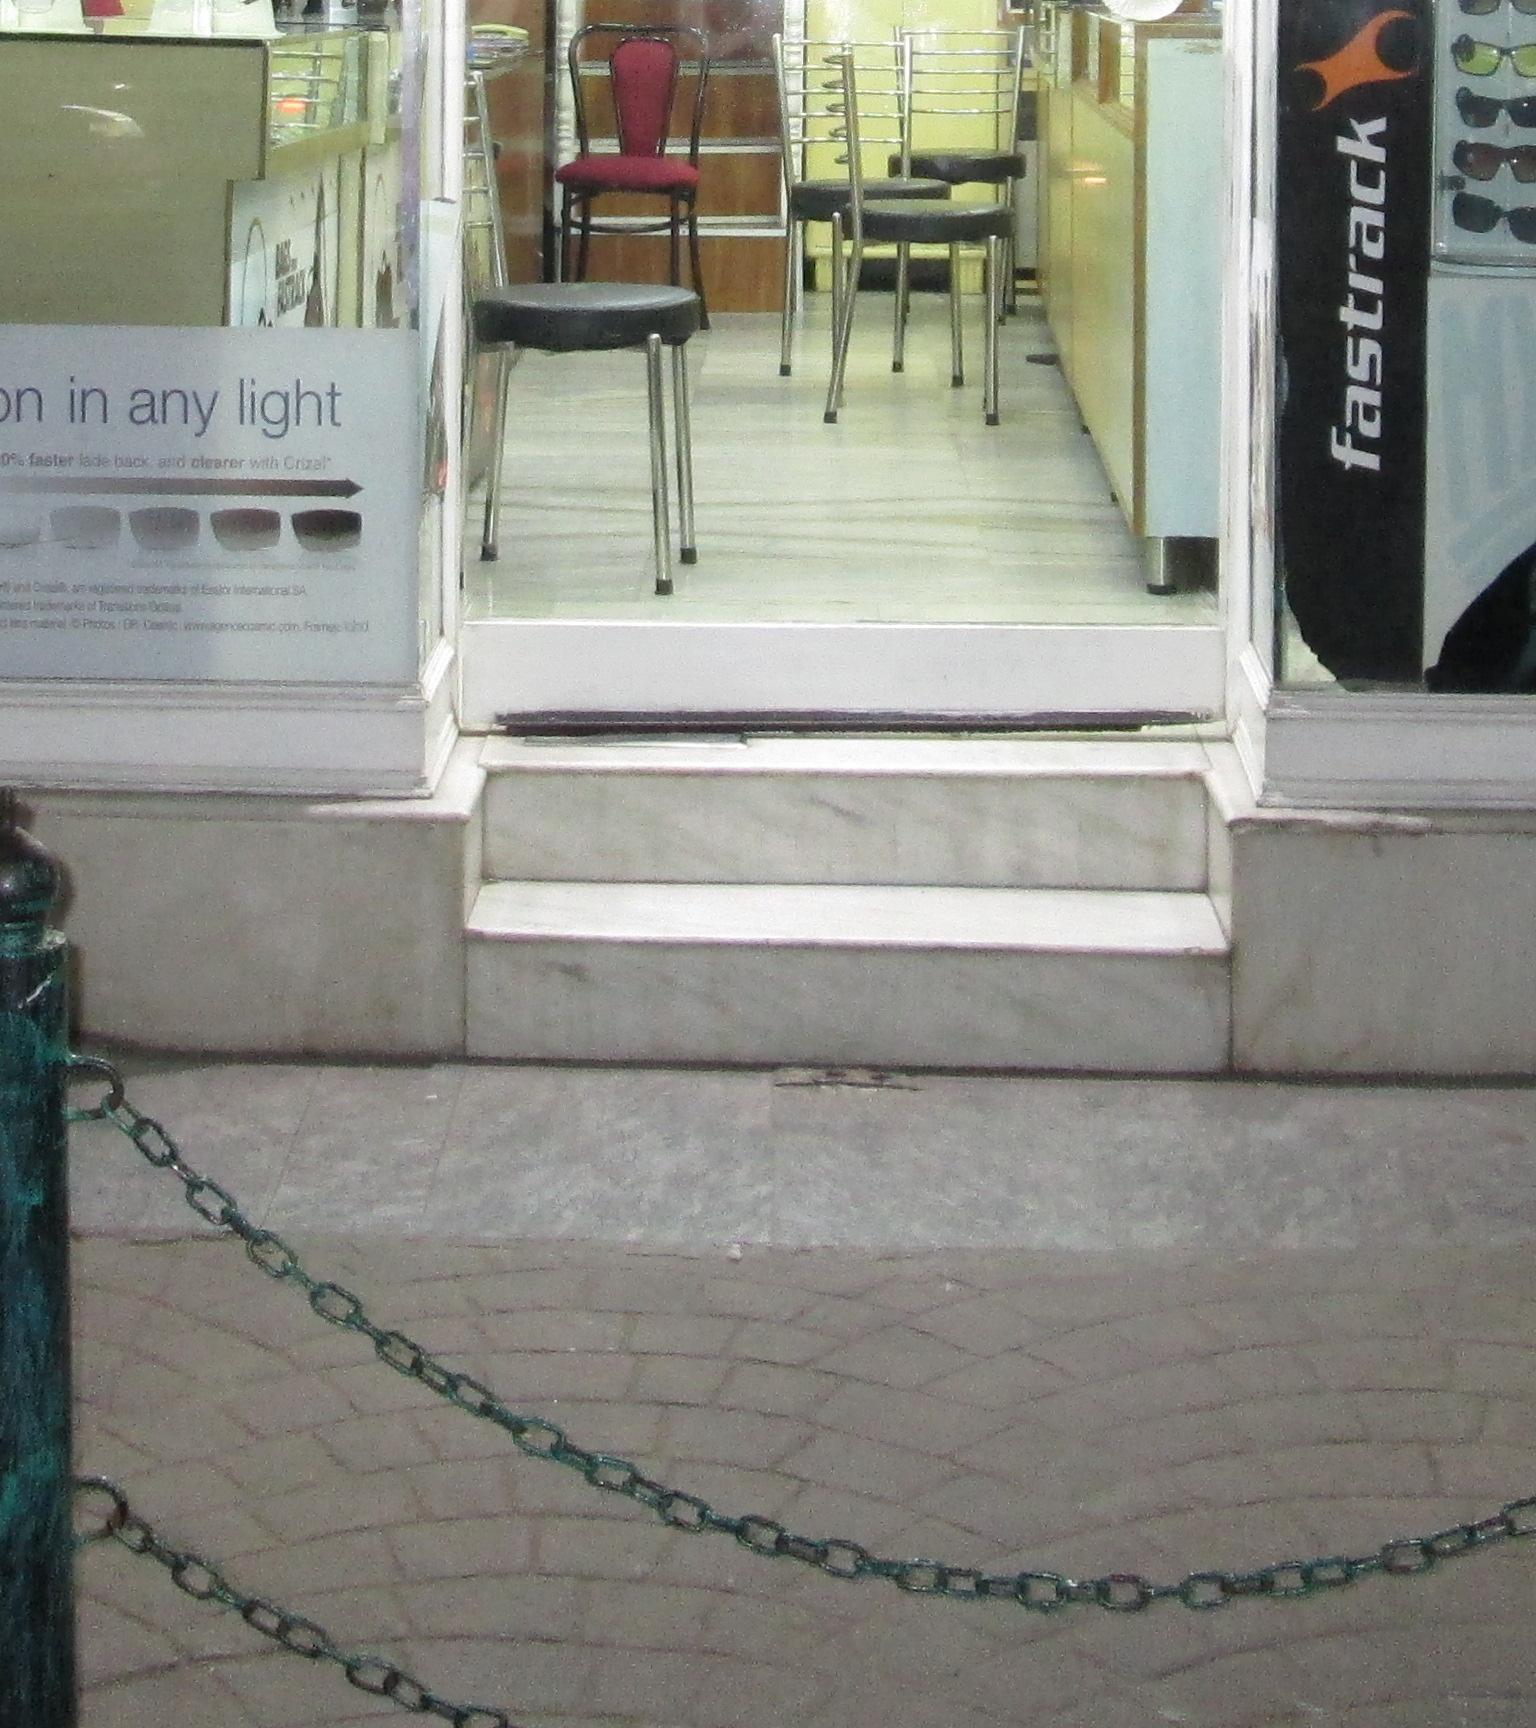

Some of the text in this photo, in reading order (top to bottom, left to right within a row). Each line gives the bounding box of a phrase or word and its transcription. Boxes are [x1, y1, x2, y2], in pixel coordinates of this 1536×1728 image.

[1331, 115, 1389, 472] fastrack
[67, 376, 109, 425] in
[128, 387, 219, 438] any
[238, 377, 342, 440] light
[29, 453, 75, 468] faster
[190, 456, 246, 470] clearer
